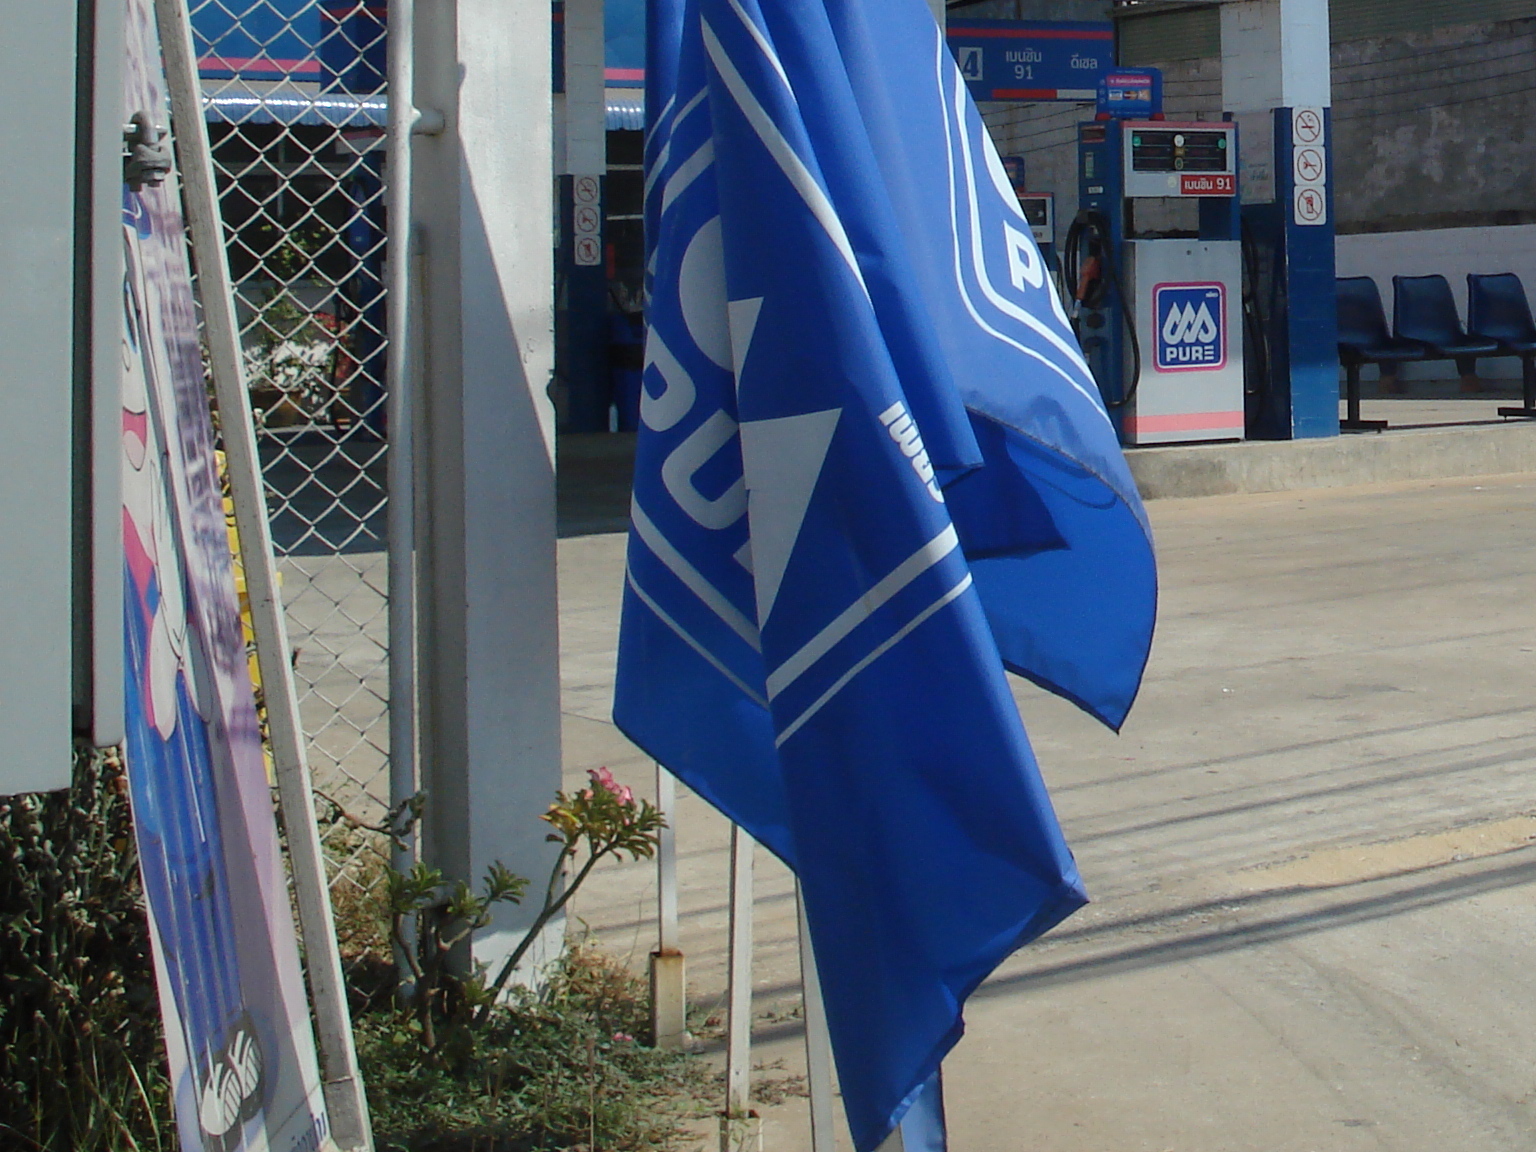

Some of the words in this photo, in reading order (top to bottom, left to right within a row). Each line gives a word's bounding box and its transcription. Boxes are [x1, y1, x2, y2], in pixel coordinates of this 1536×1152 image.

[1006, 48, 1042, 63] เบนซิน
[1070, 53, 1098, 69] ดีเซล
[1014, 64, 1034, 80] 91
[1184, 177, 1213, 191] เบนซิน
[1216, 177, 1232, 191] 91
[1165, 345, 1215, 362] PURE
